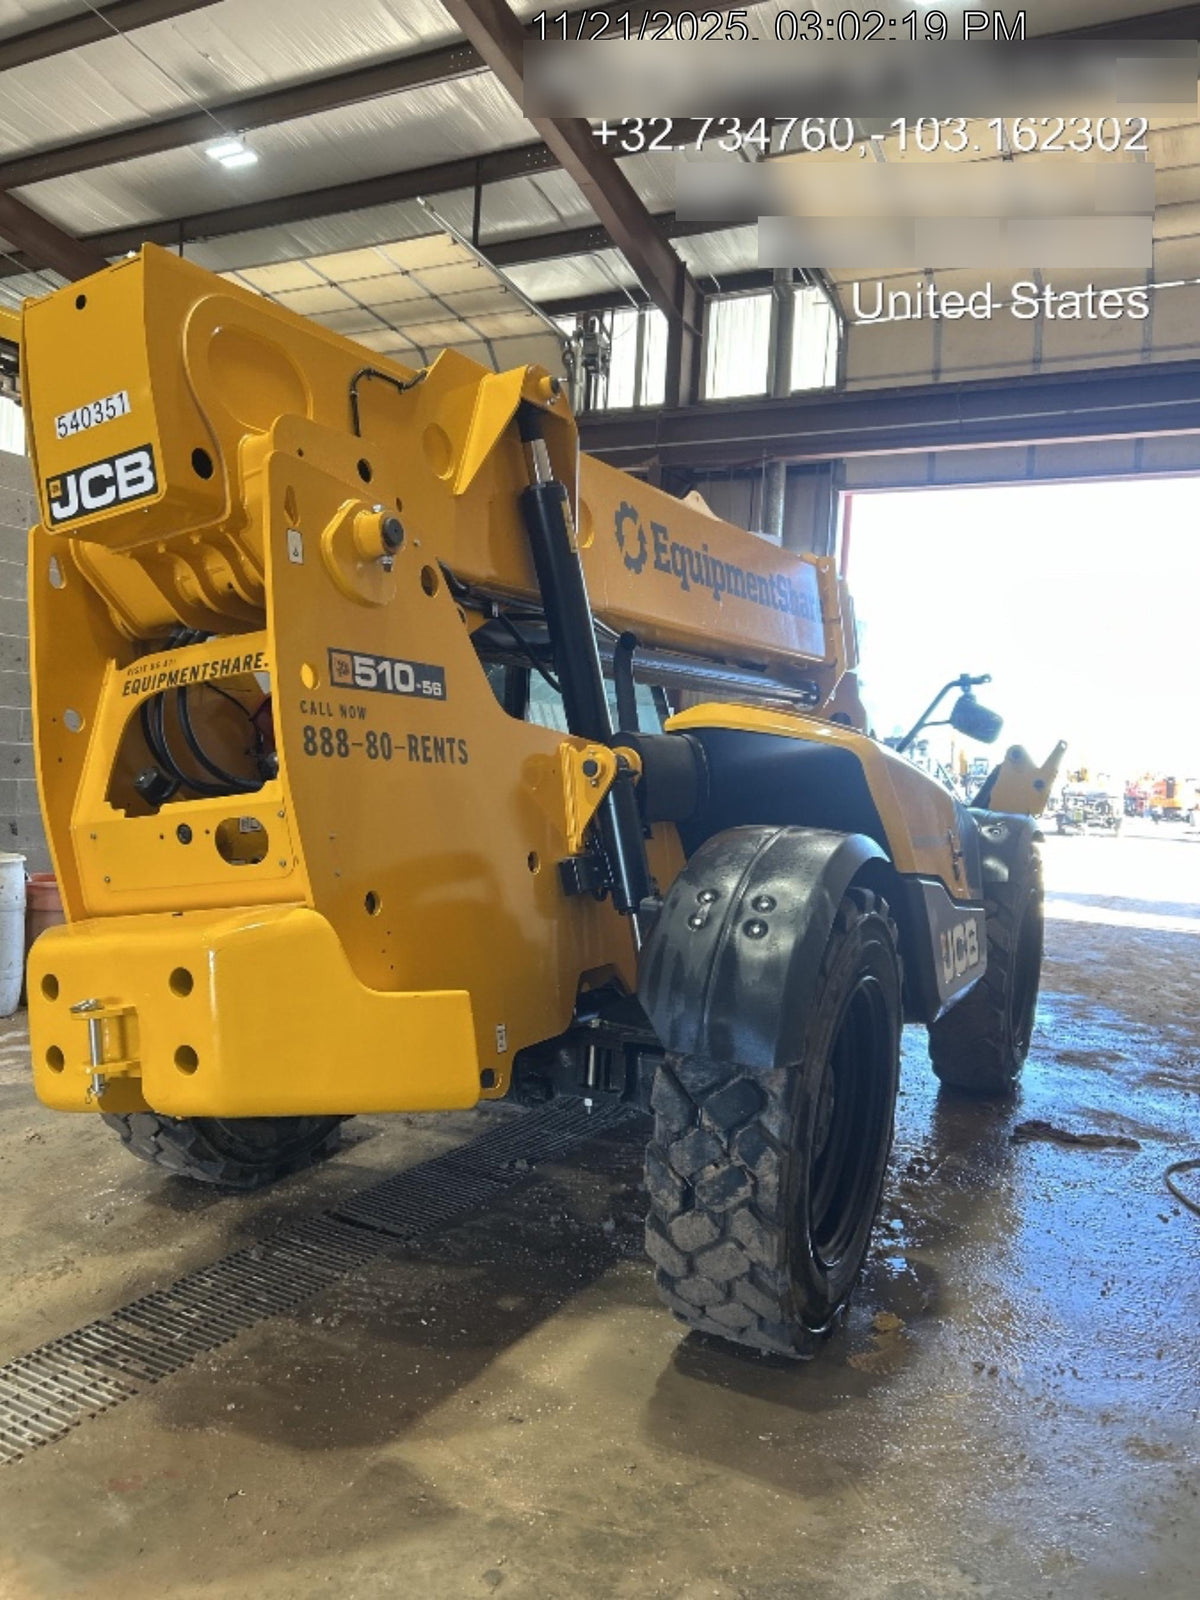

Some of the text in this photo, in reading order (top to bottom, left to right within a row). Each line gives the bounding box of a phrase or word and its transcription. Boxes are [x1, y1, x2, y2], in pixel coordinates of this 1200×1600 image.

[56, 392, 128, 438] 540351
[50, 451, 156, 519] JCB
[300, 700, 367, 720] CALL NOW
[303, 725, 469, 765] 888-80-RENTS
[940, 917, 979, 983] JCB
